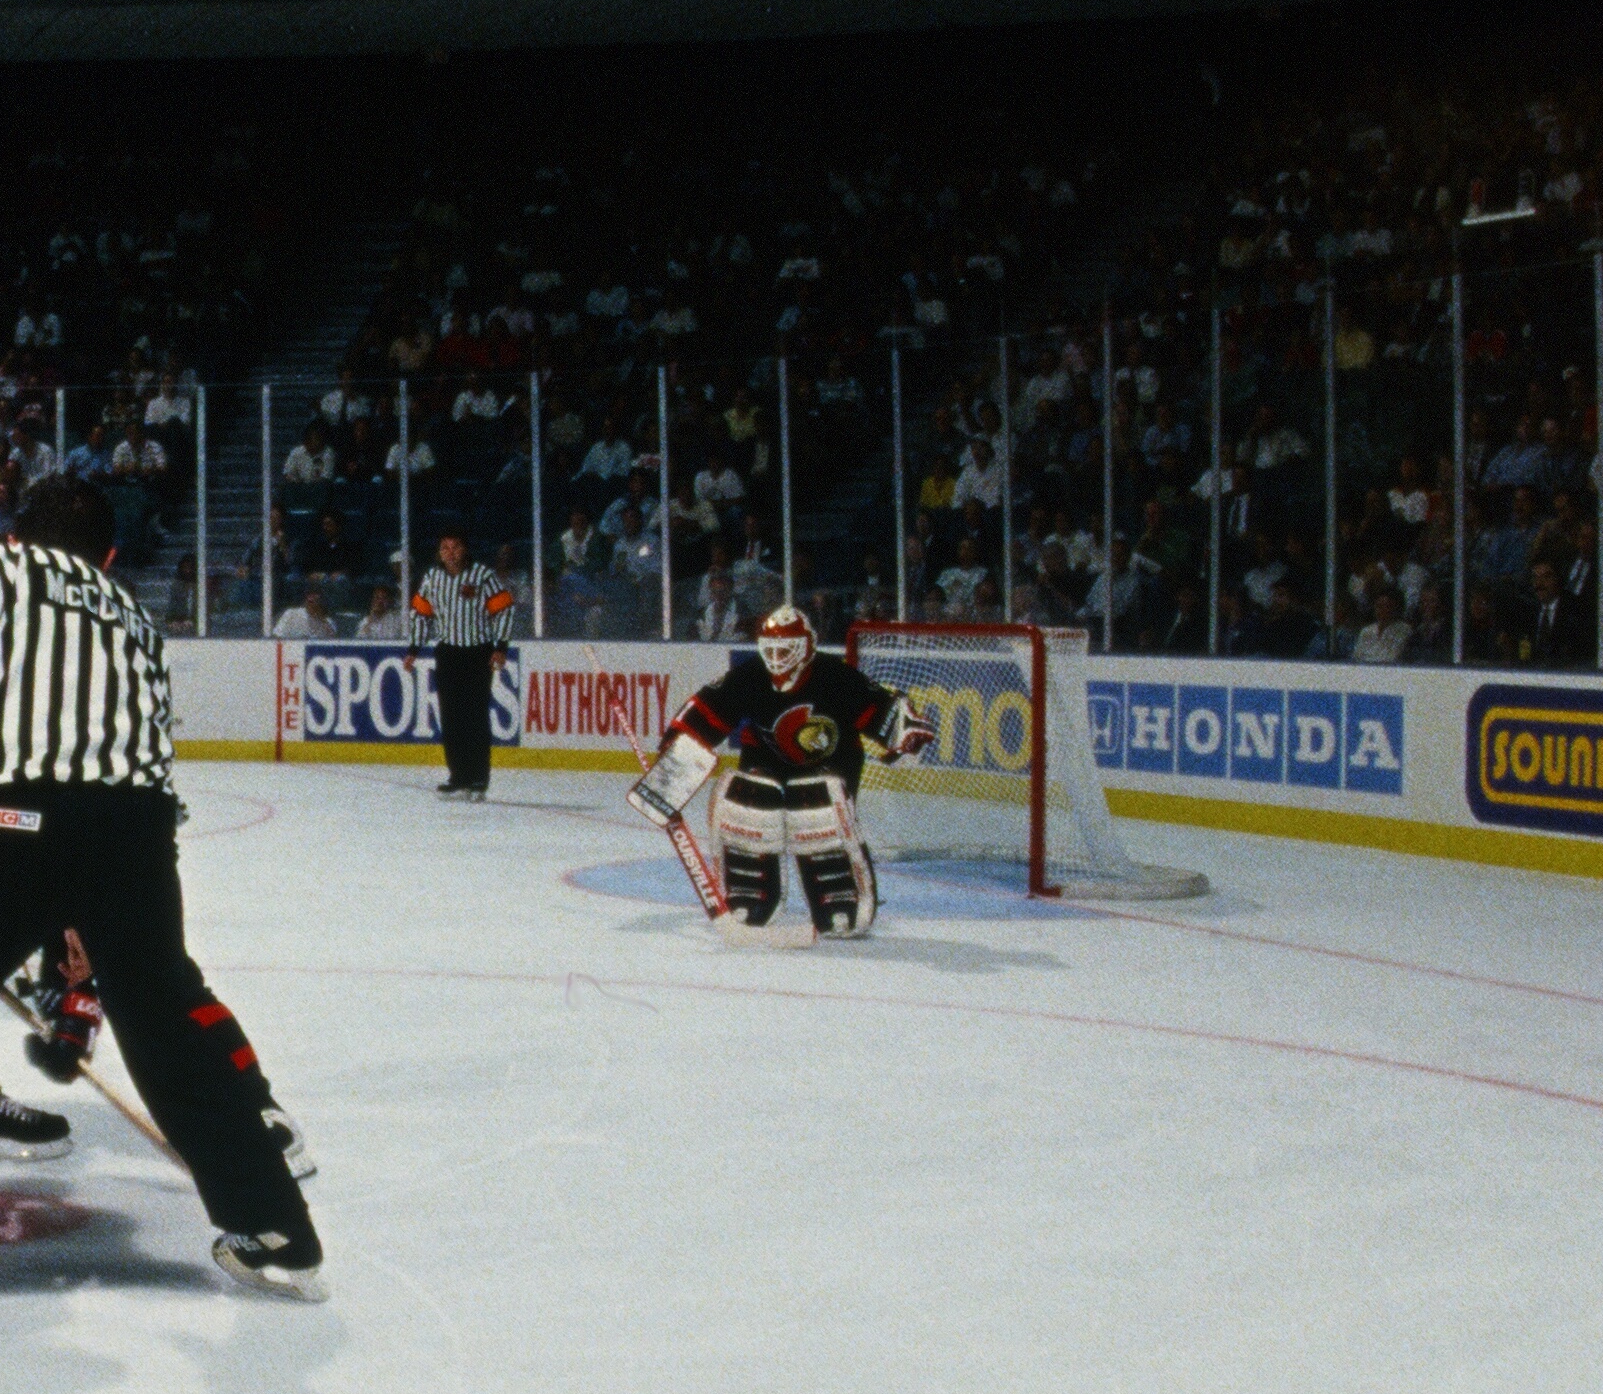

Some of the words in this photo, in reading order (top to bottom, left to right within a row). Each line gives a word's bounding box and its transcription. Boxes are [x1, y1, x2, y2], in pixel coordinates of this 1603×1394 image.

[284, 663, 300, 730] THE
[304, 655, 520, 741] SPORS
[525, 669, 671, 737] AUTHORITY
[1131, 706, 1401, 769] HONDA
[670, 824, 719, 910] LOUISVILLE
